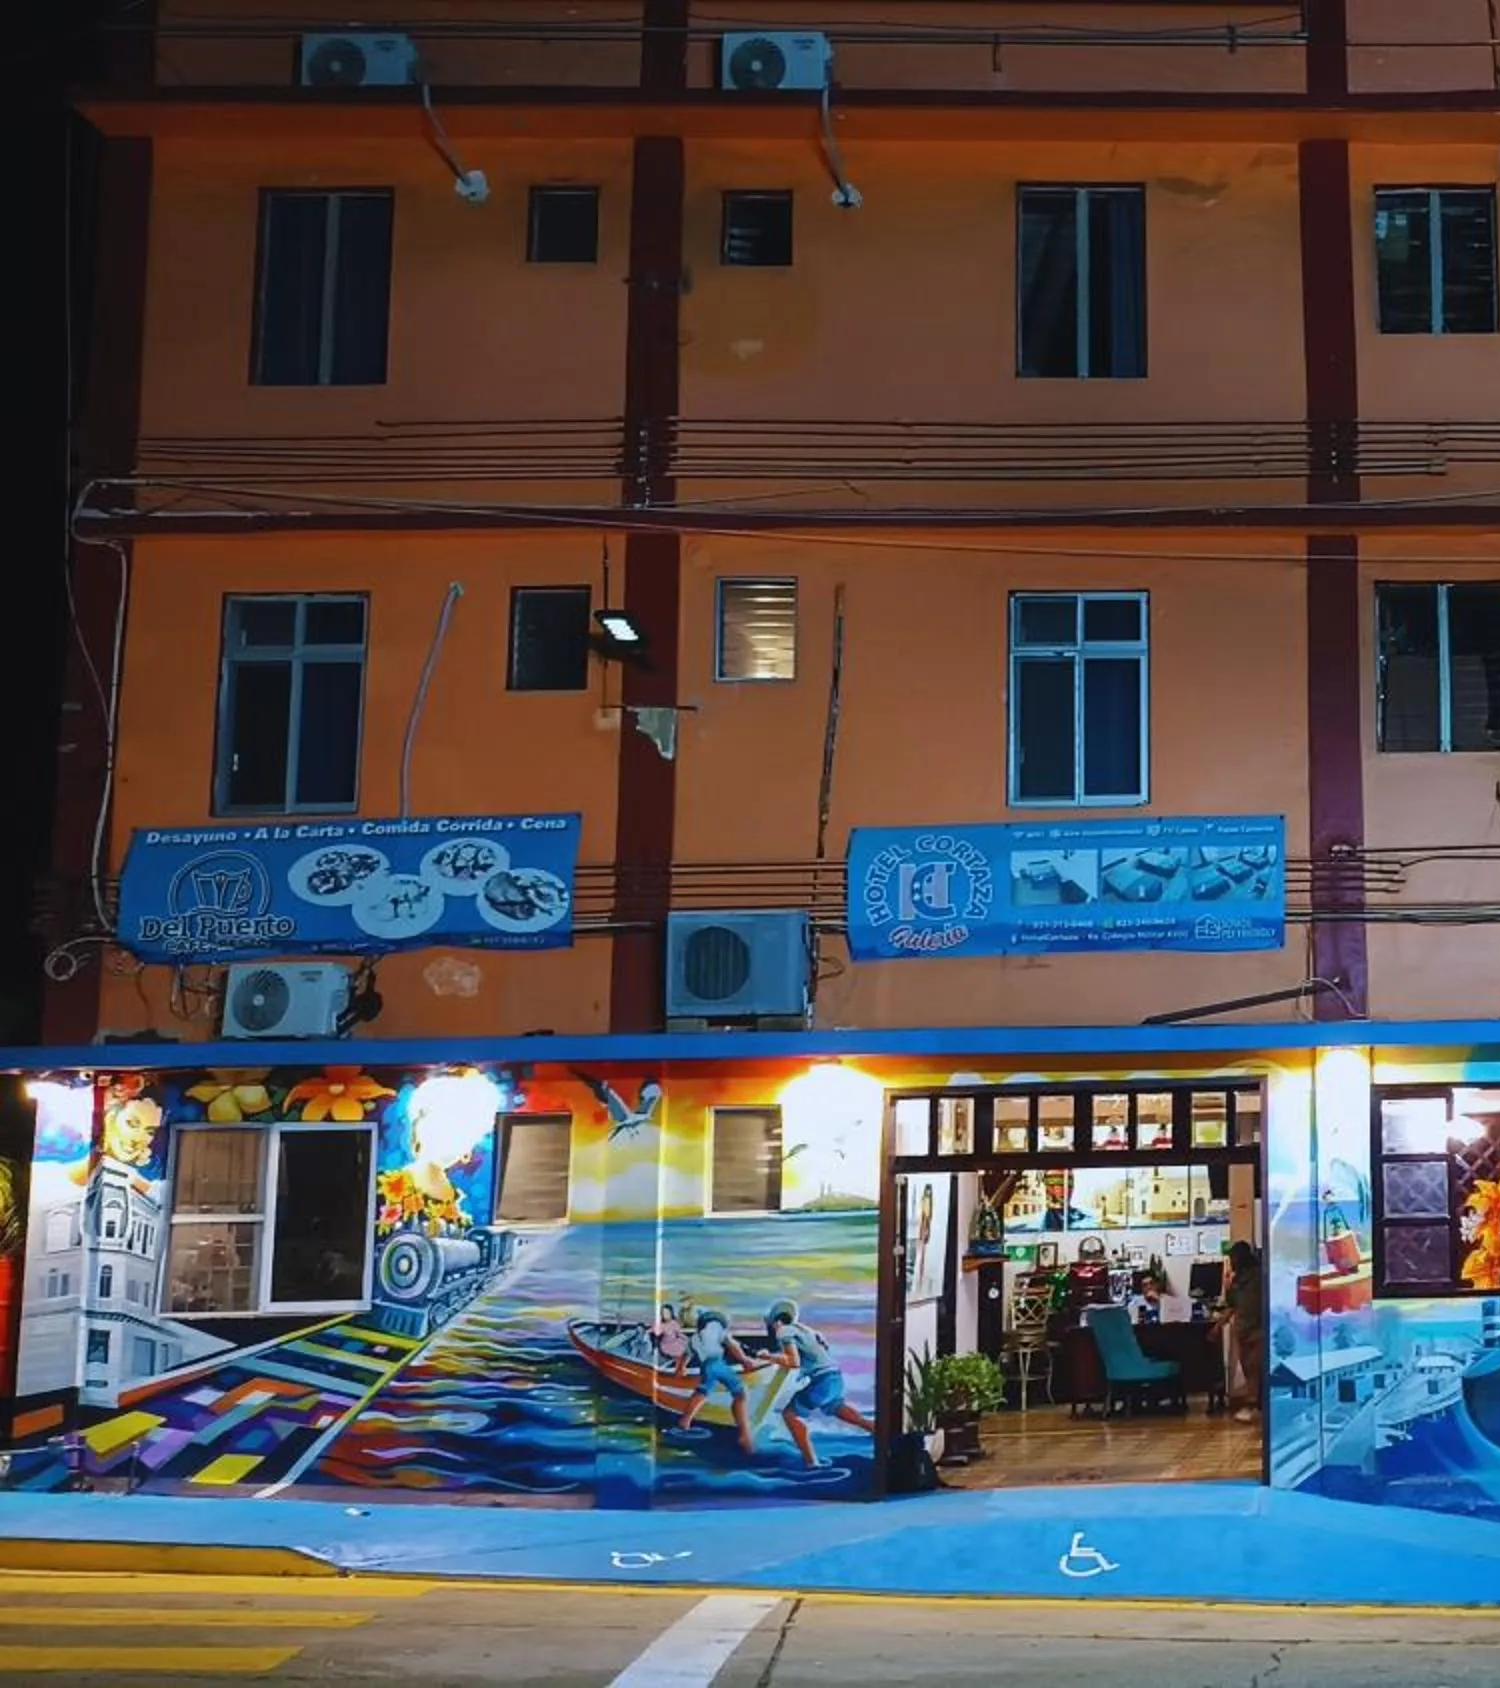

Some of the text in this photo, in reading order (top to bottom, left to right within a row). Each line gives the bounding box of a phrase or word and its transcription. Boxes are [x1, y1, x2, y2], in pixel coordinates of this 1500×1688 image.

[146, 816, 567, 846] Desayuno A la Carta Comida Corrida Cena
[864, 834, 993, 927] HOTEL CORTAZA
[136, 912, 297, 942] Del Puerto
